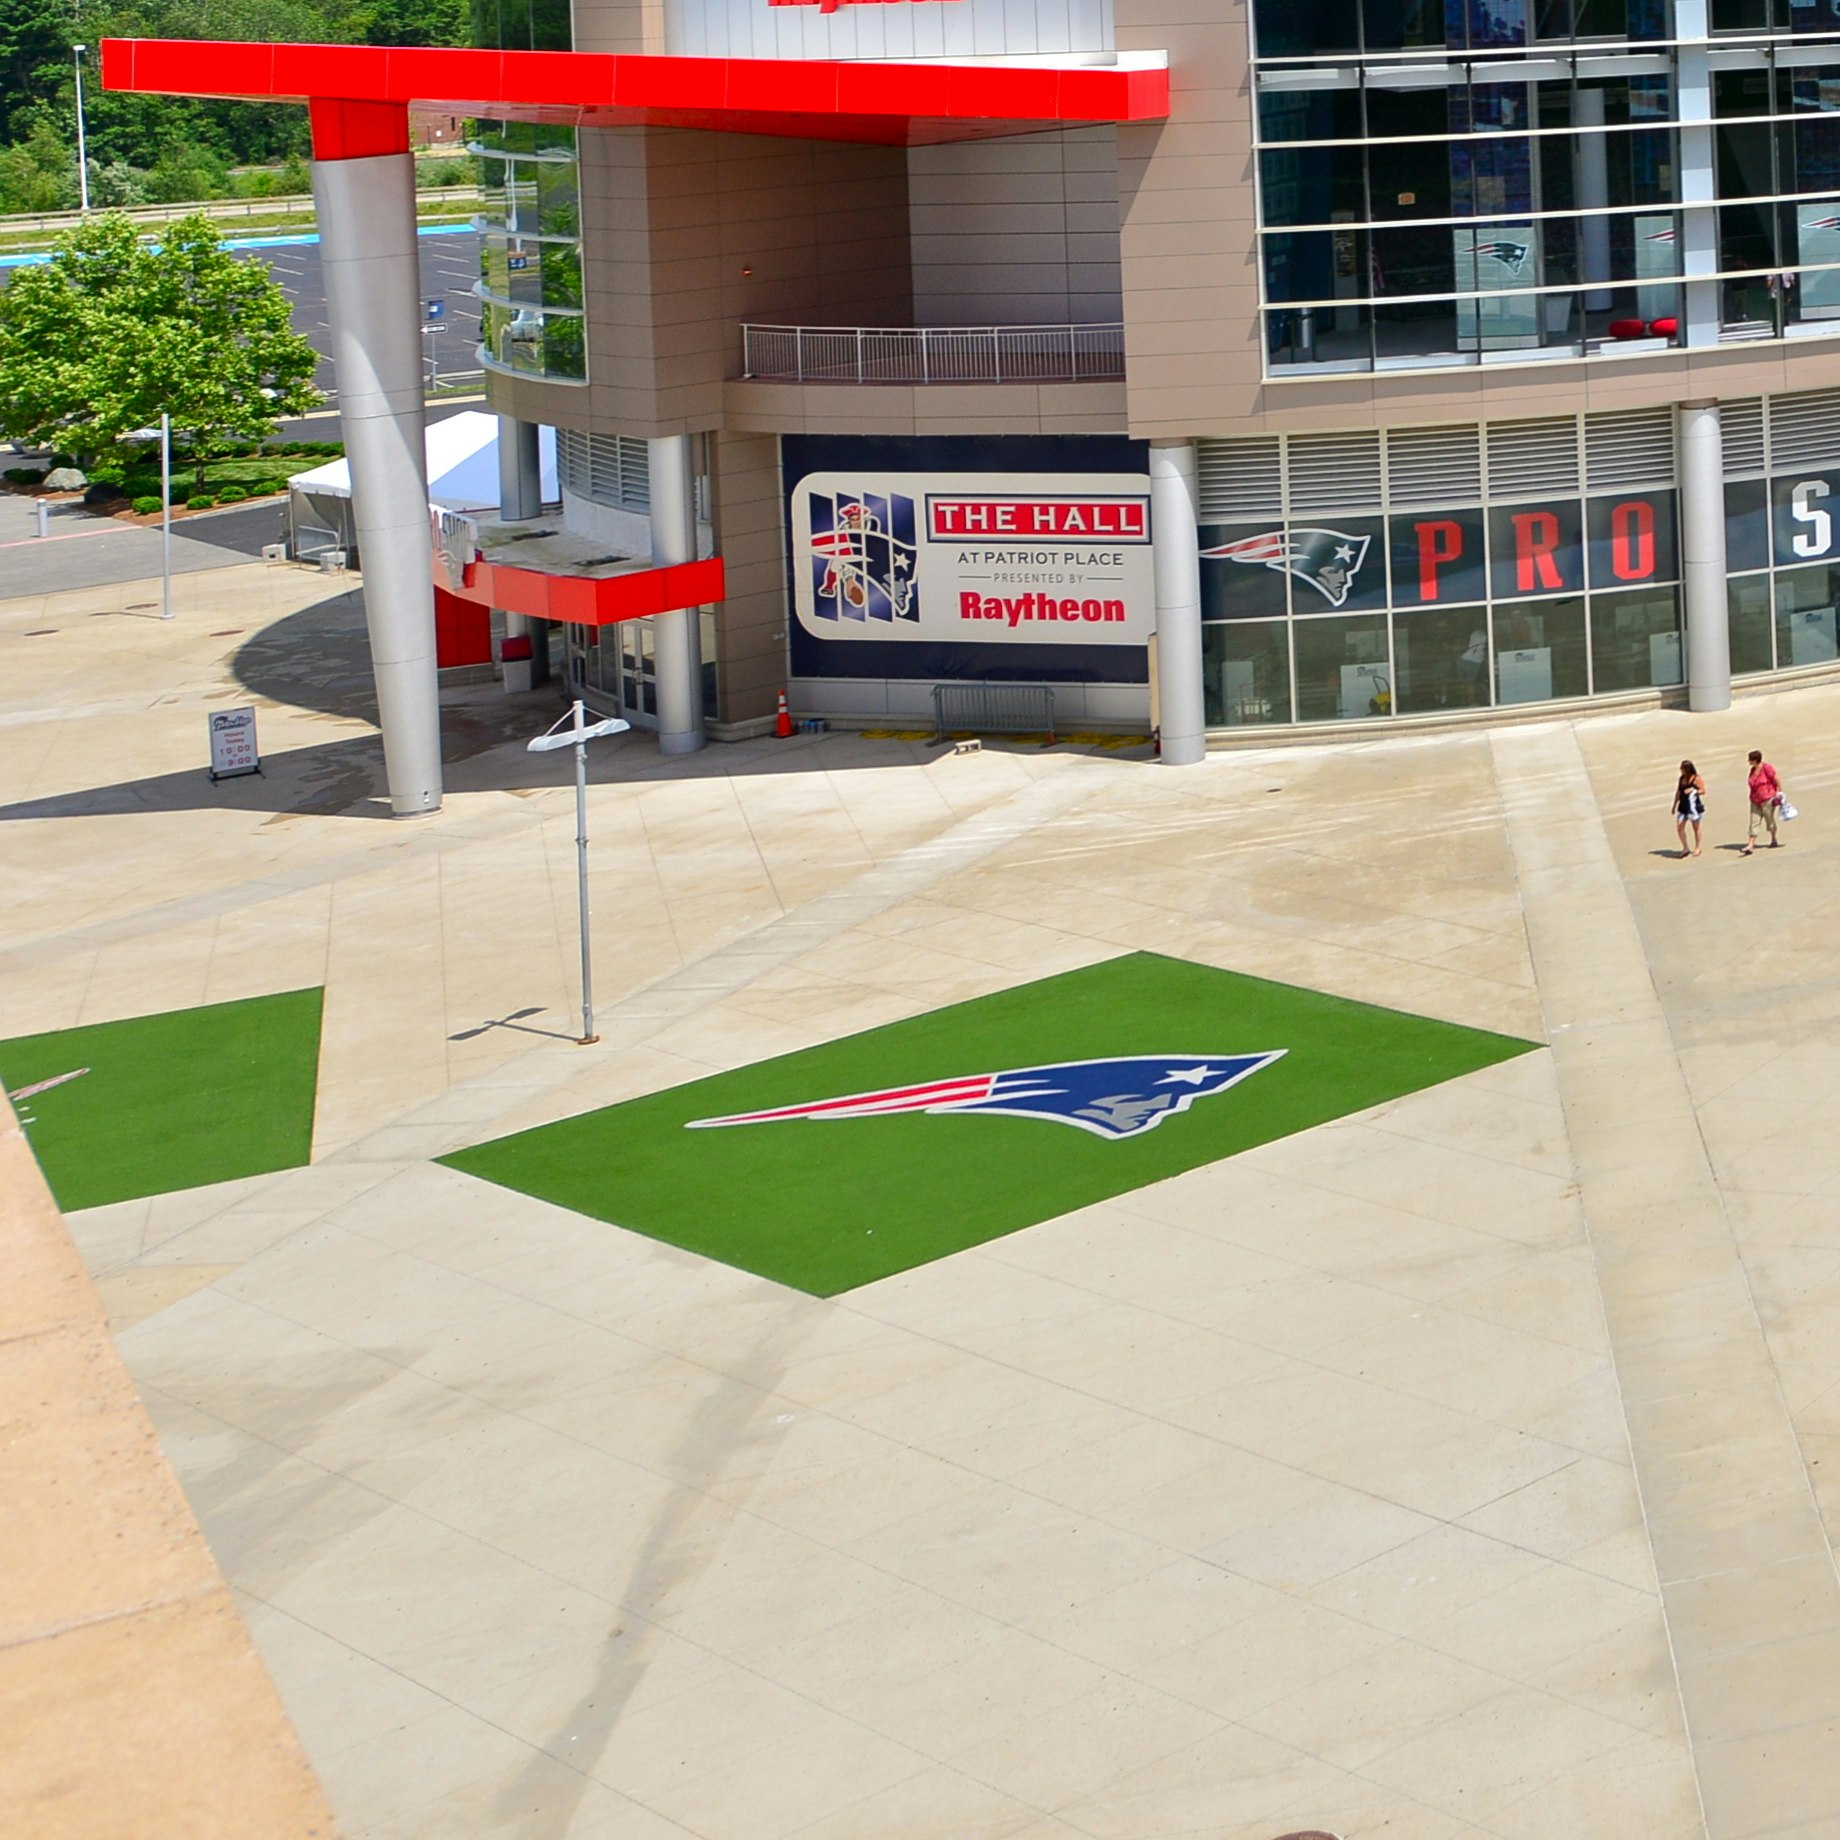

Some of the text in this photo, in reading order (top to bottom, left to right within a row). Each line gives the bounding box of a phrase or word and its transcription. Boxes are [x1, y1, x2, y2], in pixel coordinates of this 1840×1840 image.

[937, 505, 1141, 533] THE HALL
[957, 552, 1124, 566] AT PATRIOT PLACE
[1414, 501, 1656, 601] PRO
[993, 573, 1083, 584] PRESENTED BY
[959, 592, 1125, 628] Raytheon
